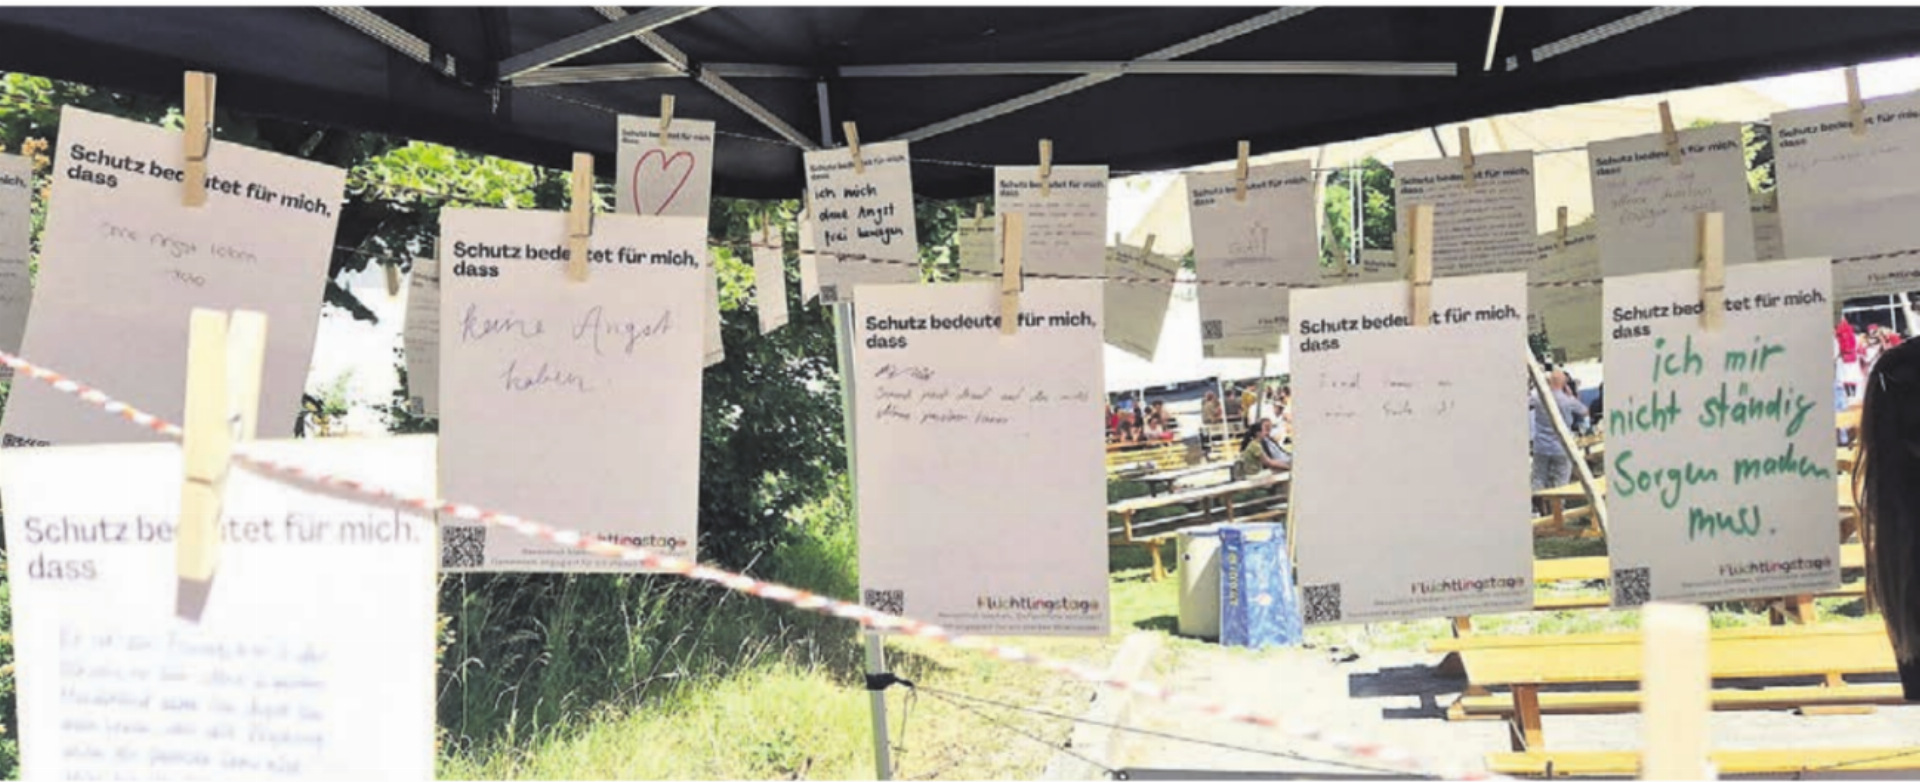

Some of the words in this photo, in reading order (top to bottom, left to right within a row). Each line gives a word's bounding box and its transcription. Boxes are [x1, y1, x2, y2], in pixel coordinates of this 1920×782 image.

[1878, 112, 1896, 123] für
[1687, 144, 1705, 154] für
[0, 174, 27, 189] ich,
[67, 166, 119, 189] dass
[71, 143, 145, 175] Schutz
[149, 159, 243, 196] bedtet
[246, 183, 278, 203] für
[815, 186, 836, 200] ich
[843, 183, 877, 199] mich
[857, 202, 894, 226] Angst
[150, 232, 197, 259] Angst
[824, 227, 848, 248] frei
[857, 226, 904, 246] bewegen
[453, 241, 522, 259] Schutz
[525, 243, 614, 264] bedetet
[617, 246, 649, 265] für
[650, 249, 699, 269] mich,
[453, 260, 499, 278] dass
[1612, 304, 1669, 323] Schutz
[1672, 298, 1751, 317] bedtet
[1754, 293, 1780, 308] für
[462, 302, 545, 343] keine
[571, 305, 675, 355] Angst
[865, 314, 927, 332] Schutz
[930, 313, 1003, 331] bedeute
[1016, 311, 1045, 328] für
[1300, 316, 1358, 336] Schutz
[1362, 311, 1442, 331] bedeut
[1444, 307, 1470, 325] für
[1612, 324, 1651, 340] dass
[865, 333, 907, 350] dass
[1300, 337, 1340, 353] dass
[1653, 334, 1702, 382] ich
[1725, 335, 1786, 374] mir
[1610, 389, 1681, 436] nicht
[1700, 382, 1817, 437] ständig
[1613, 450, 1718, 508] Sorgen
[1734, 442, 1831, 485] machen
[24, 514, 128, 544] Schutz
[136, 514, 274, 544] betet
[284, 513, 332, 546] für
[28, 553, 97, 581] dass
